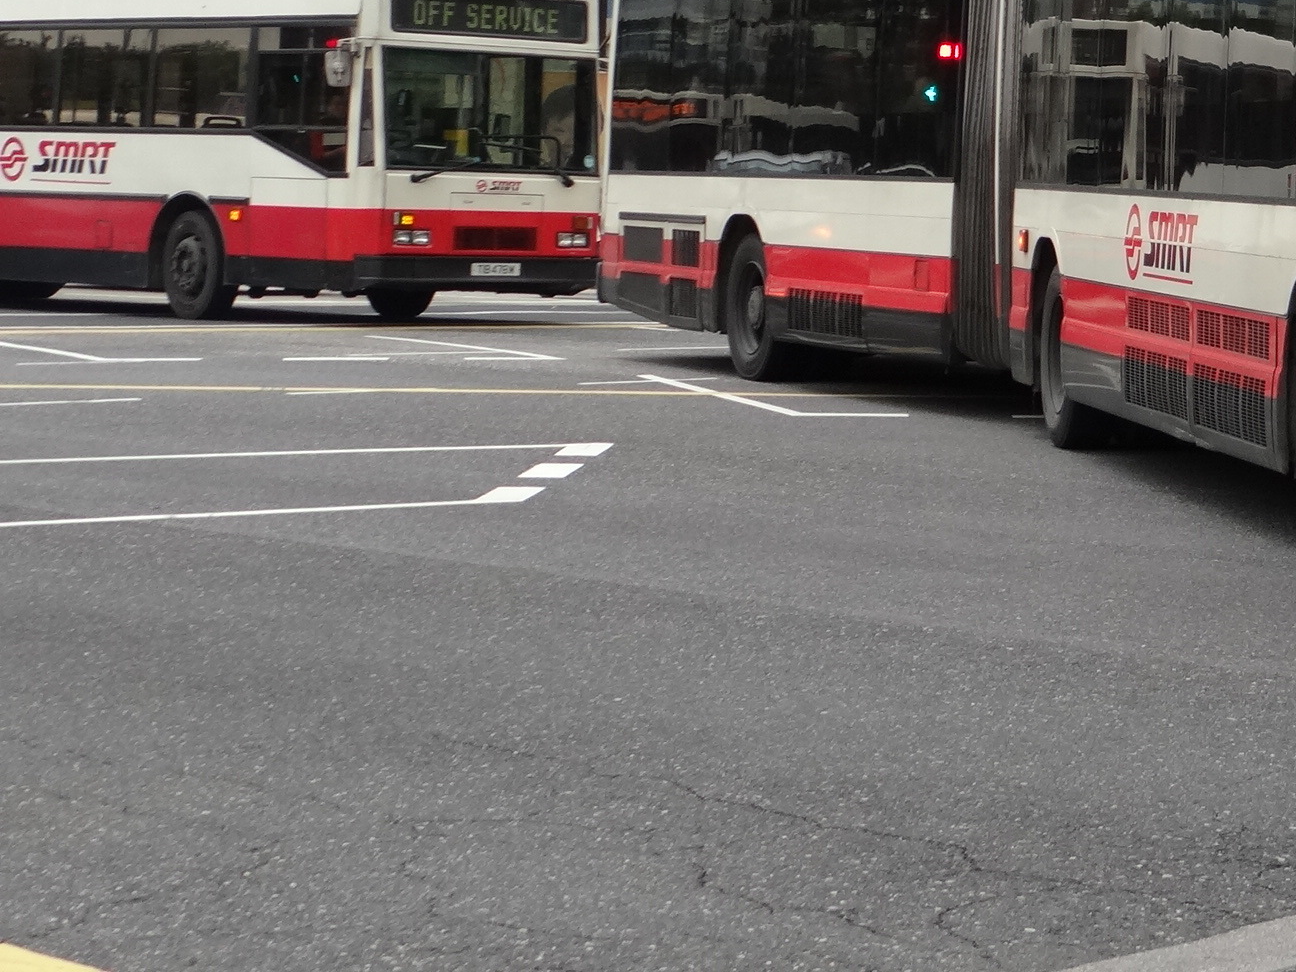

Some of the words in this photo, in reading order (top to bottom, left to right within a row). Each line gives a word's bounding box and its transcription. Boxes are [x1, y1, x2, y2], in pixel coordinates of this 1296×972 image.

[413, 0, 456, 26] OFF
[466, 3, 559, 34] SERVICE
[33, 140, 117, 174] SMRT
[490, 180, 522, 192] SMRT
[1143, 211, 1198, 273] SMRT
